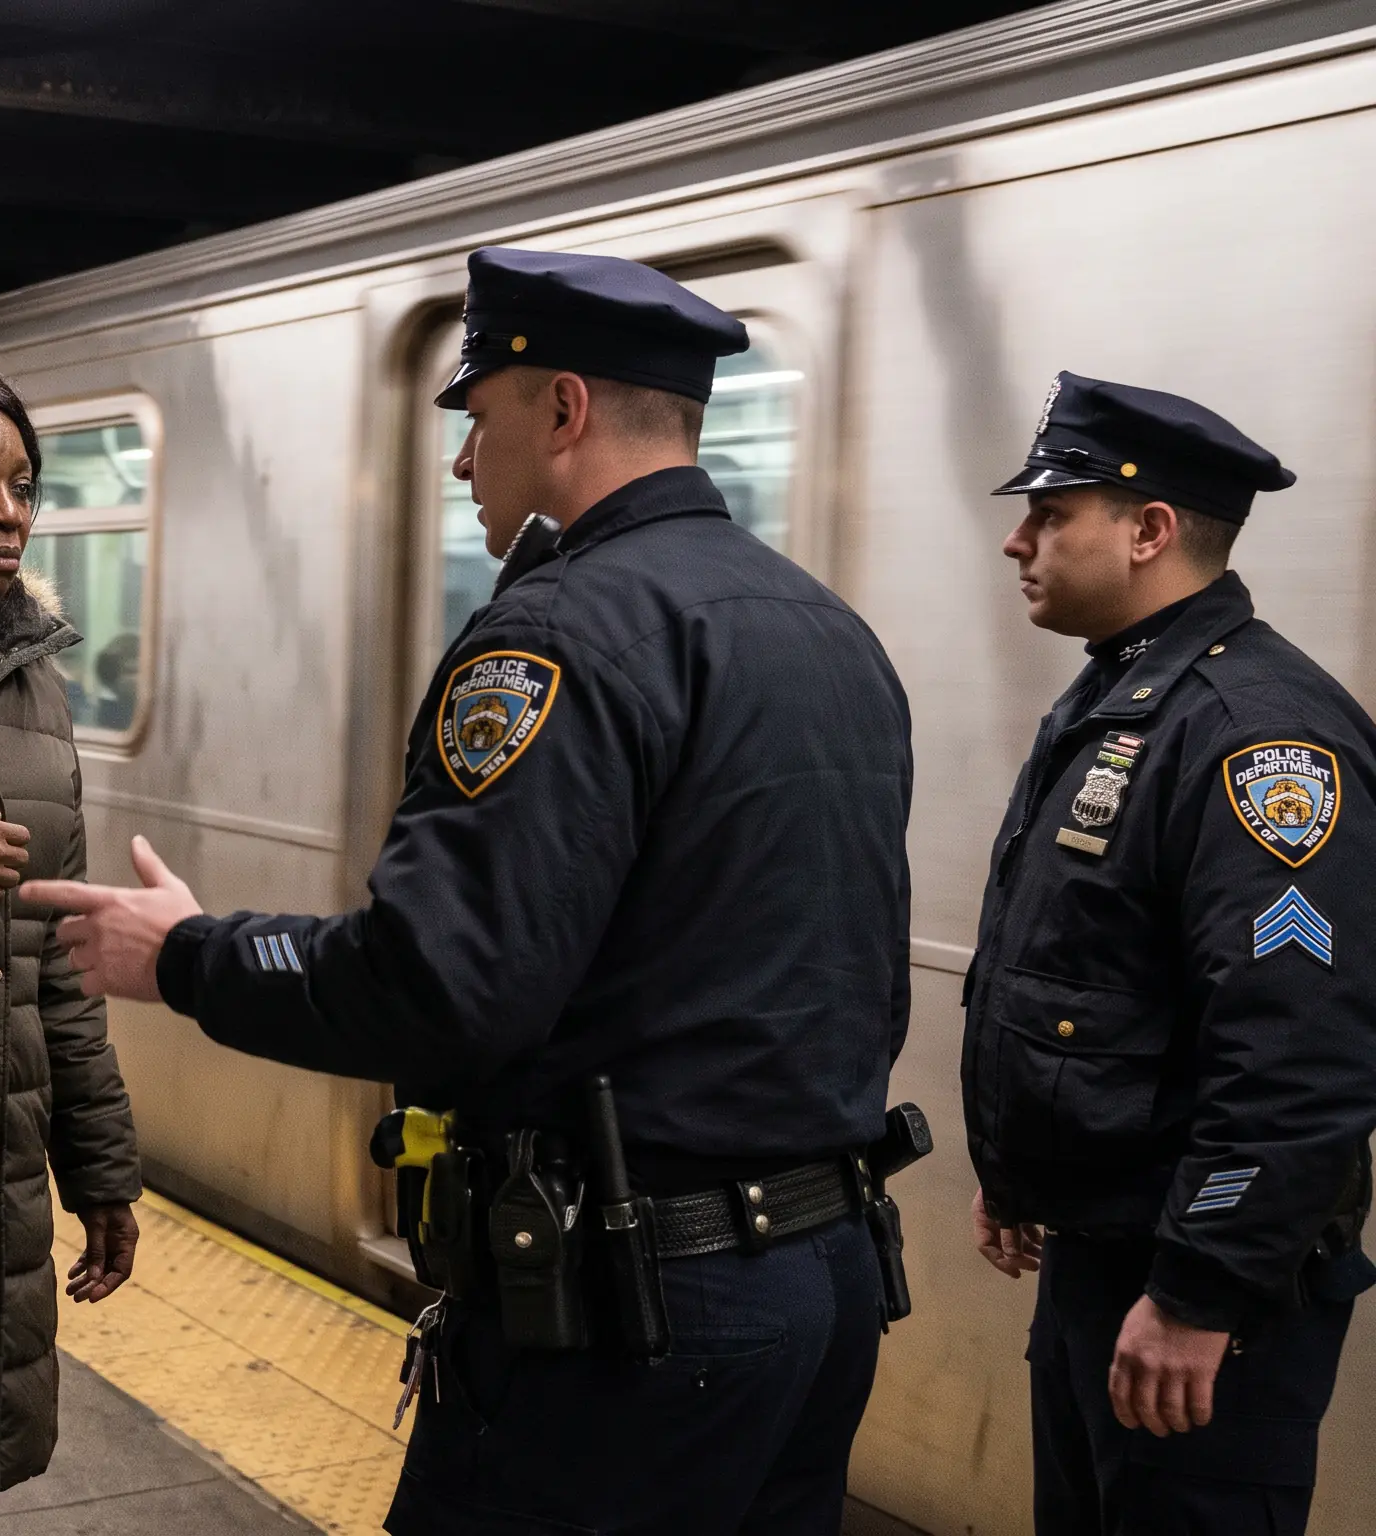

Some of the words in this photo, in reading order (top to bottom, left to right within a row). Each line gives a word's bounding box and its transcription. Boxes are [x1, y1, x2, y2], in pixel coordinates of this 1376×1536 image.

[472, 660, 528, 677] POLICE
[451, 674, 543, 700] DEPARTMENT
[443, 718, 455, 748] CITY
[508, 707, 540, 748] YORK
[1253, 748, 1312, 764] POLICE
[1236, 760, 1330, 786] DEPARTMENT
[1239, 800, 1263, 827] CITY
[1260, 828, 1278, 842] OF
[1319, 790, 1335, 823] YORK
